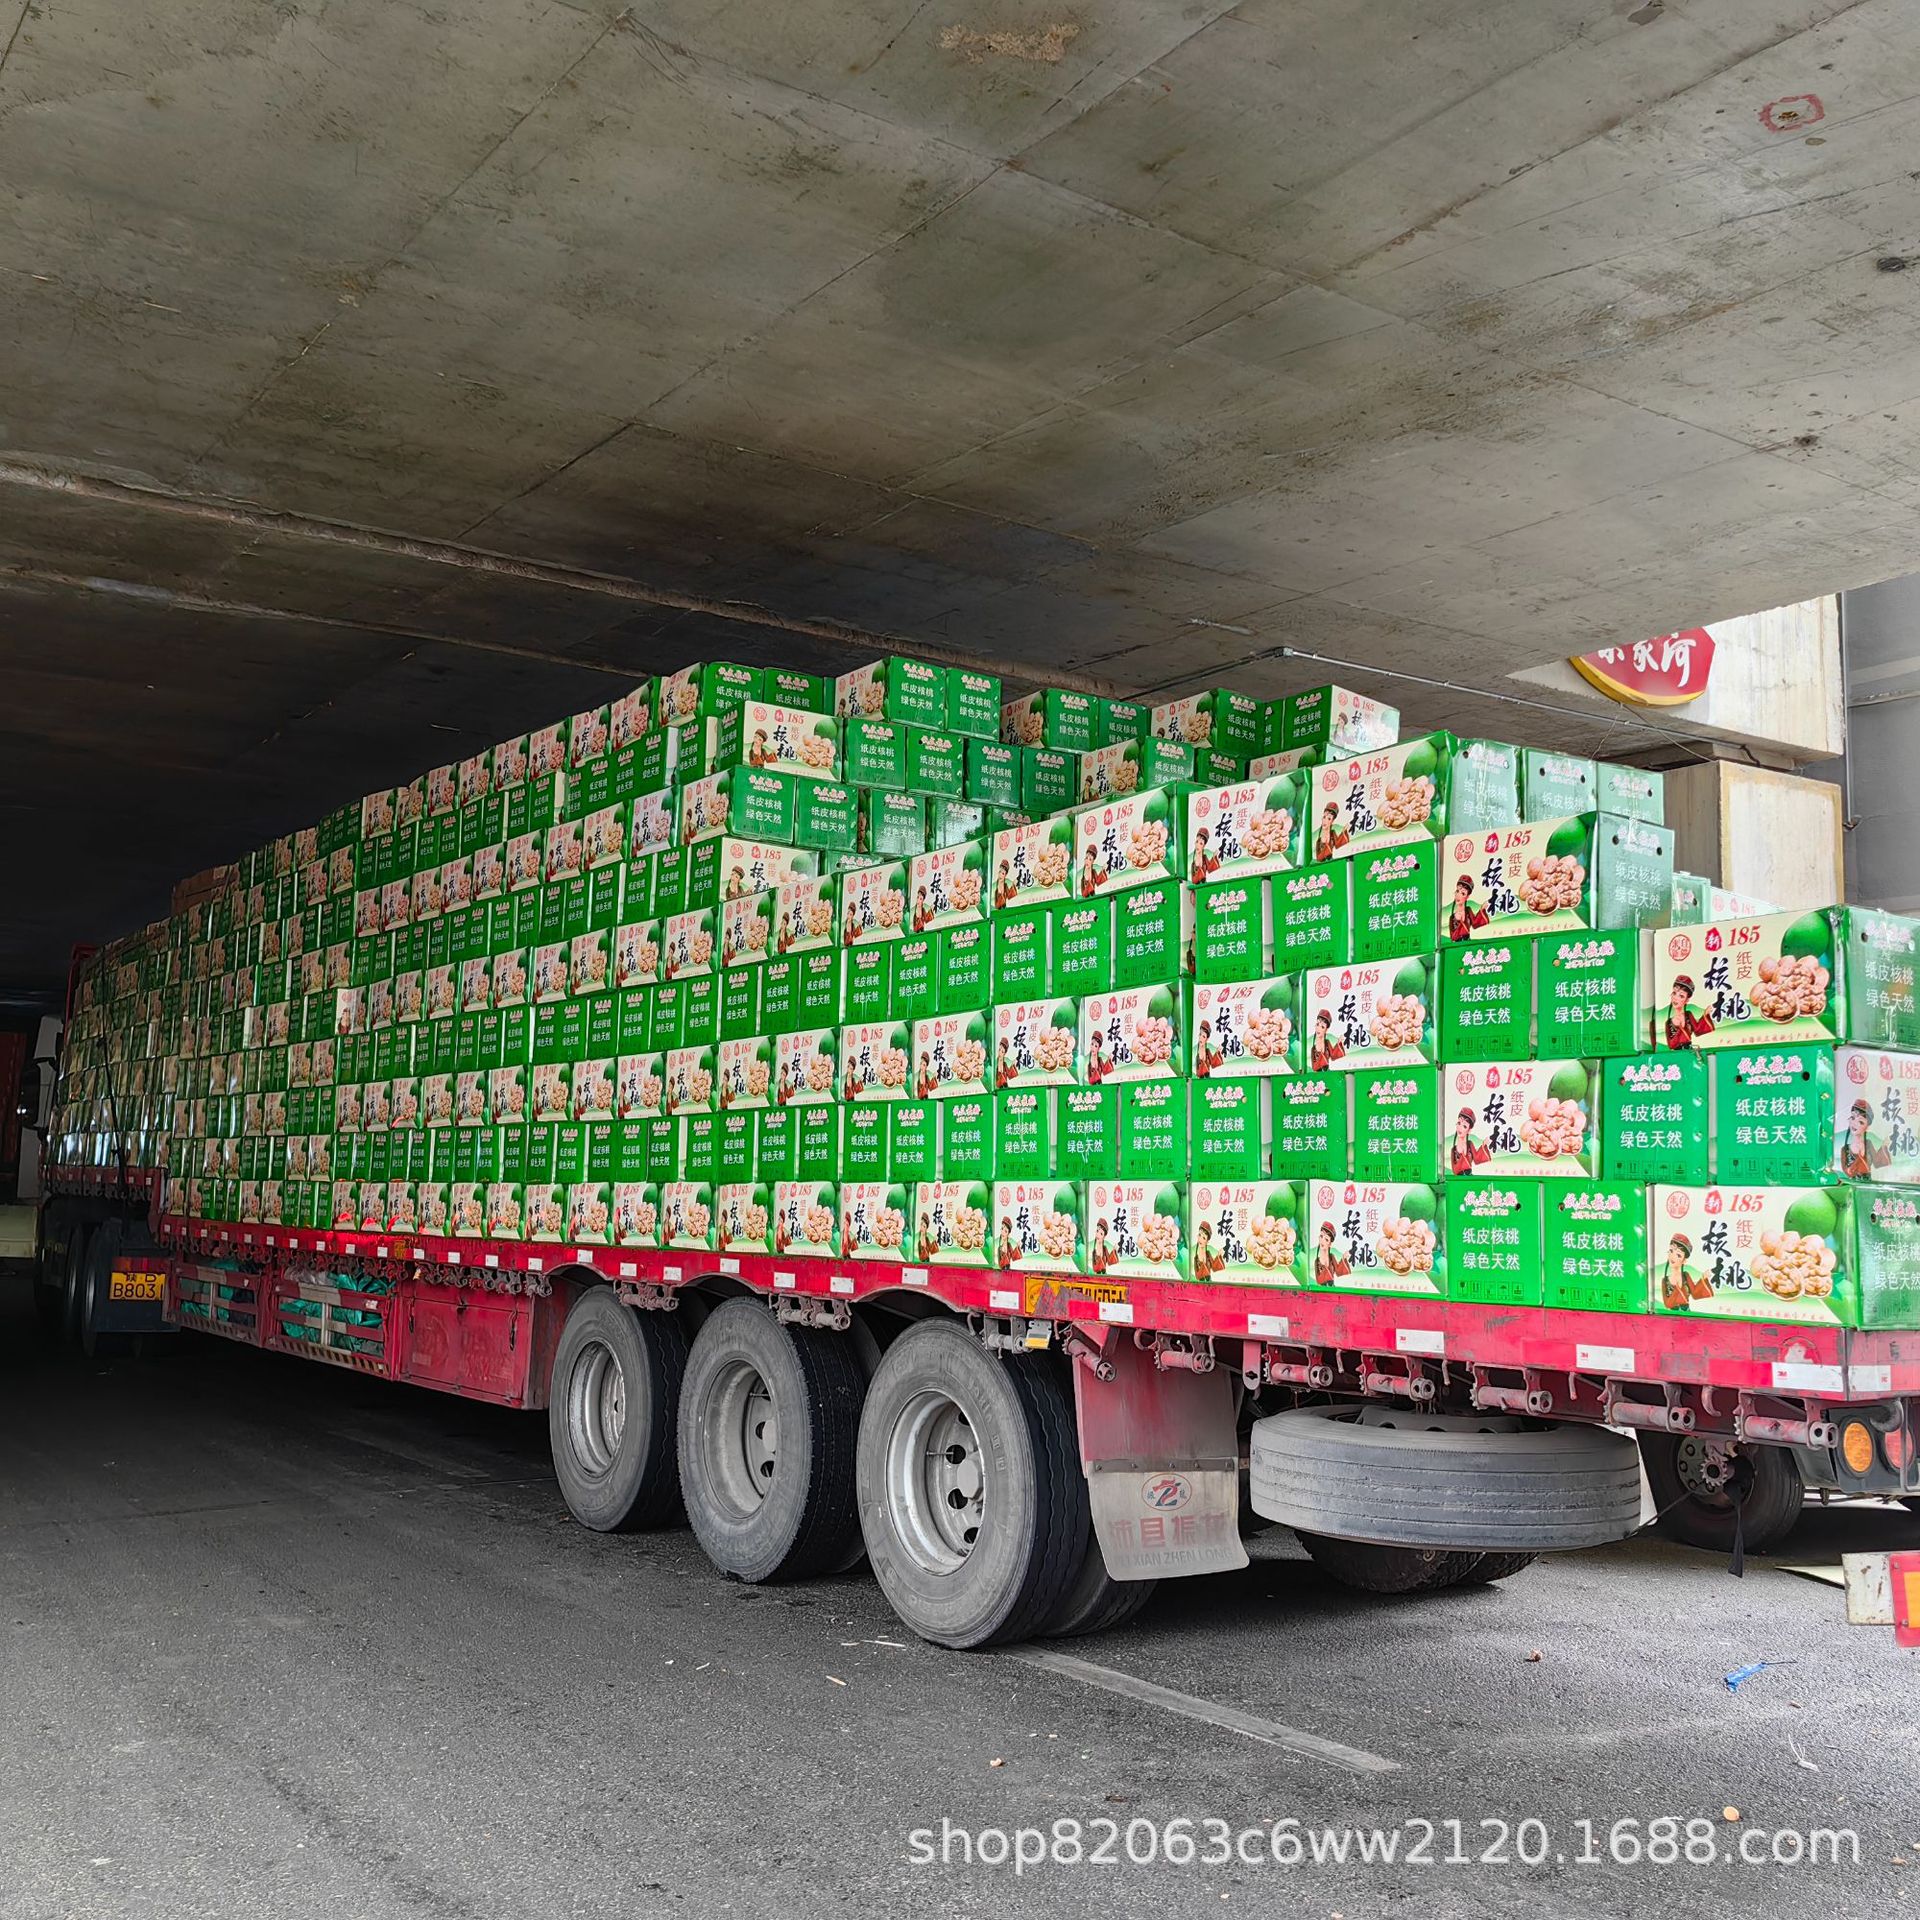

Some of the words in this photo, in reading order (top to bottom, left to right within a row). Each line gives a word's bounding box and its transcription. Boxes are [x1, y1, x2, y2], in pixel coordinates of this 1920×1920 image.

[901, 681, 934, 698] 纸皮核桃
[901, 694, 933, 711] 绿色天然
[1059, 710, 1089, 728] 纸皮核桃
[1227, 711, 1256, 730] 纸皮核桃
[1293, 709, 1321, 729] 纸皮核桃
[1059, 724, 1089, 739] 绿色天然
[1227, 725, 1255, 741] 绿色天然
[1292, 723, 1321, 739] 绿色天然
[860, 743, 895, 759] 纸皮核桃
[981, 765, 1012, 779] 纸皮核桃
[1365, 755, 1389, 775] 185
[981, 776, 1011, 792] 绿色天然
[1369, 777, 1382, 800] 纸皮
[746, 794, 782, 812] 纸皮核桃
[1234, 789, 1254, 805] 185
[746, 808, 782, 824] 绿色天然
[1236, 808, 1249, 829] 纸皮
[1345, 784, 1376, 835] 核桃
[1215, 813, 1241, 861] 核桃
[1504, 830, 1531, 848] 185
[1508, 852, 1522, 878] 纸皮
[1480, 858, 1519, 918] 核桃
[1368, 887, 1418, 908] 纸皮核桃
[1286, 908, 1331, 927] 纸皮核桃
[1368, 908, 1418, 930] 绿色天然
[1126, 919, 1164, 939] 纸皮核桃
[1208, 919, 1246, 938] 纸皮核桃
[1286, 928, 1331, 946] 绿色天然
[1728, 926, 1760, 946] 185
[1004, 948, 1035, 964] 纸皮核桃
[1126, 938, 1164, 958] 绿色天然
[1207, 941, 1246, 958] 绿色天然
[900, 966, 927, 980] 纸皮核桃
[1737, 951, 1752, 979] 纸皮
[1865, 960, 1913, 986] 纸皮核桃
[1003, 967, 1035, 982] 绿色天然
[1357, 969, 1379, 986] 185
[767, 985, 789, 999] 纸皮核桃
[807, 977, 831, 993] 纸皮核桃
[899, 983, 926, 998] 绿色天然
[1231, 987, 1254, 999] 185
[1460, 983, 1511, 1002] 纸皮核桃
[1556, 977, 1616, 998] 纸皮核桃
[1703, 957, 1751, 1023] 核桃
[806, 993, 830, 1007] 绿色天然
[1866, 989, 1914, 1013] 绿色天然
[1338, 995, 1370, 1050] 核桃
[1459, 1008, 1510, 1026] 绿色天然
[1555, 1003, 1615, 1024] 绿色天然
[1216, 1007, 1244, 1058] 核桃
[1506, 1068, 1532, 1084] 185
[1510, 1091, 1524, 1117] 纸皮
[1736, 1097, 1805, 1117] 纸皮核桃
[1906, 1087, 1919, 1116] 纸皮
[1133, 1114, 1172, 1129] 纸皮核桃
[1283, 1113, 1327, 1129] 纸皮核桃
[1621, 1104, 1682, 1122] 纸皮核桃
[1005, 1121, 1037, 1136] 纸皮核桃
[1204, 1117, 1244, 1132] 纸皮核桃
[1368, 1114, 1418, 1131] 纸皮核桃
[1484, 1094, 1521, 1153] 核桃
[1880, 1087, 1919, 1159] 核桃
[1133, 1135, 1172, 1150] 绿色天然
[1283, 1136, 1327, 1151] 绿色天然
[1621, 1131, 1682, 1148] 绿色天然
[1736, 1126, 1806, 1144] 绿色天然
[1203, 1139, 1244, 1153] 绿色天然
[1368, 1138, 1417, 1154] 绿色天然
[1234, 1188, 1254, 1202] 185
[1362, 1188, 1385, 1202] 185
[1729, 1194, 1764, 1212] 185
[1217, 1210, 1247, 1263] 核桃
[1342, 1210, 1377, 1269] 核桃
[1463, 1228, 1519, 1244] 纸皮核桃
[1563, 1232, 1624, 1250] 纸皮核桃
[1737, 1220, 1752, 1248] 纸皮
[1463, 1252, 1520, 1270] 绿色天然
[1702, 1221, 1751, 1290] 核桃
[1563, 1258, 1624, 1277] 绿色天然
[1134, 1552, 1162, 1568] XIAN
[1164, 1550, 1196, 1565] ZHEN
